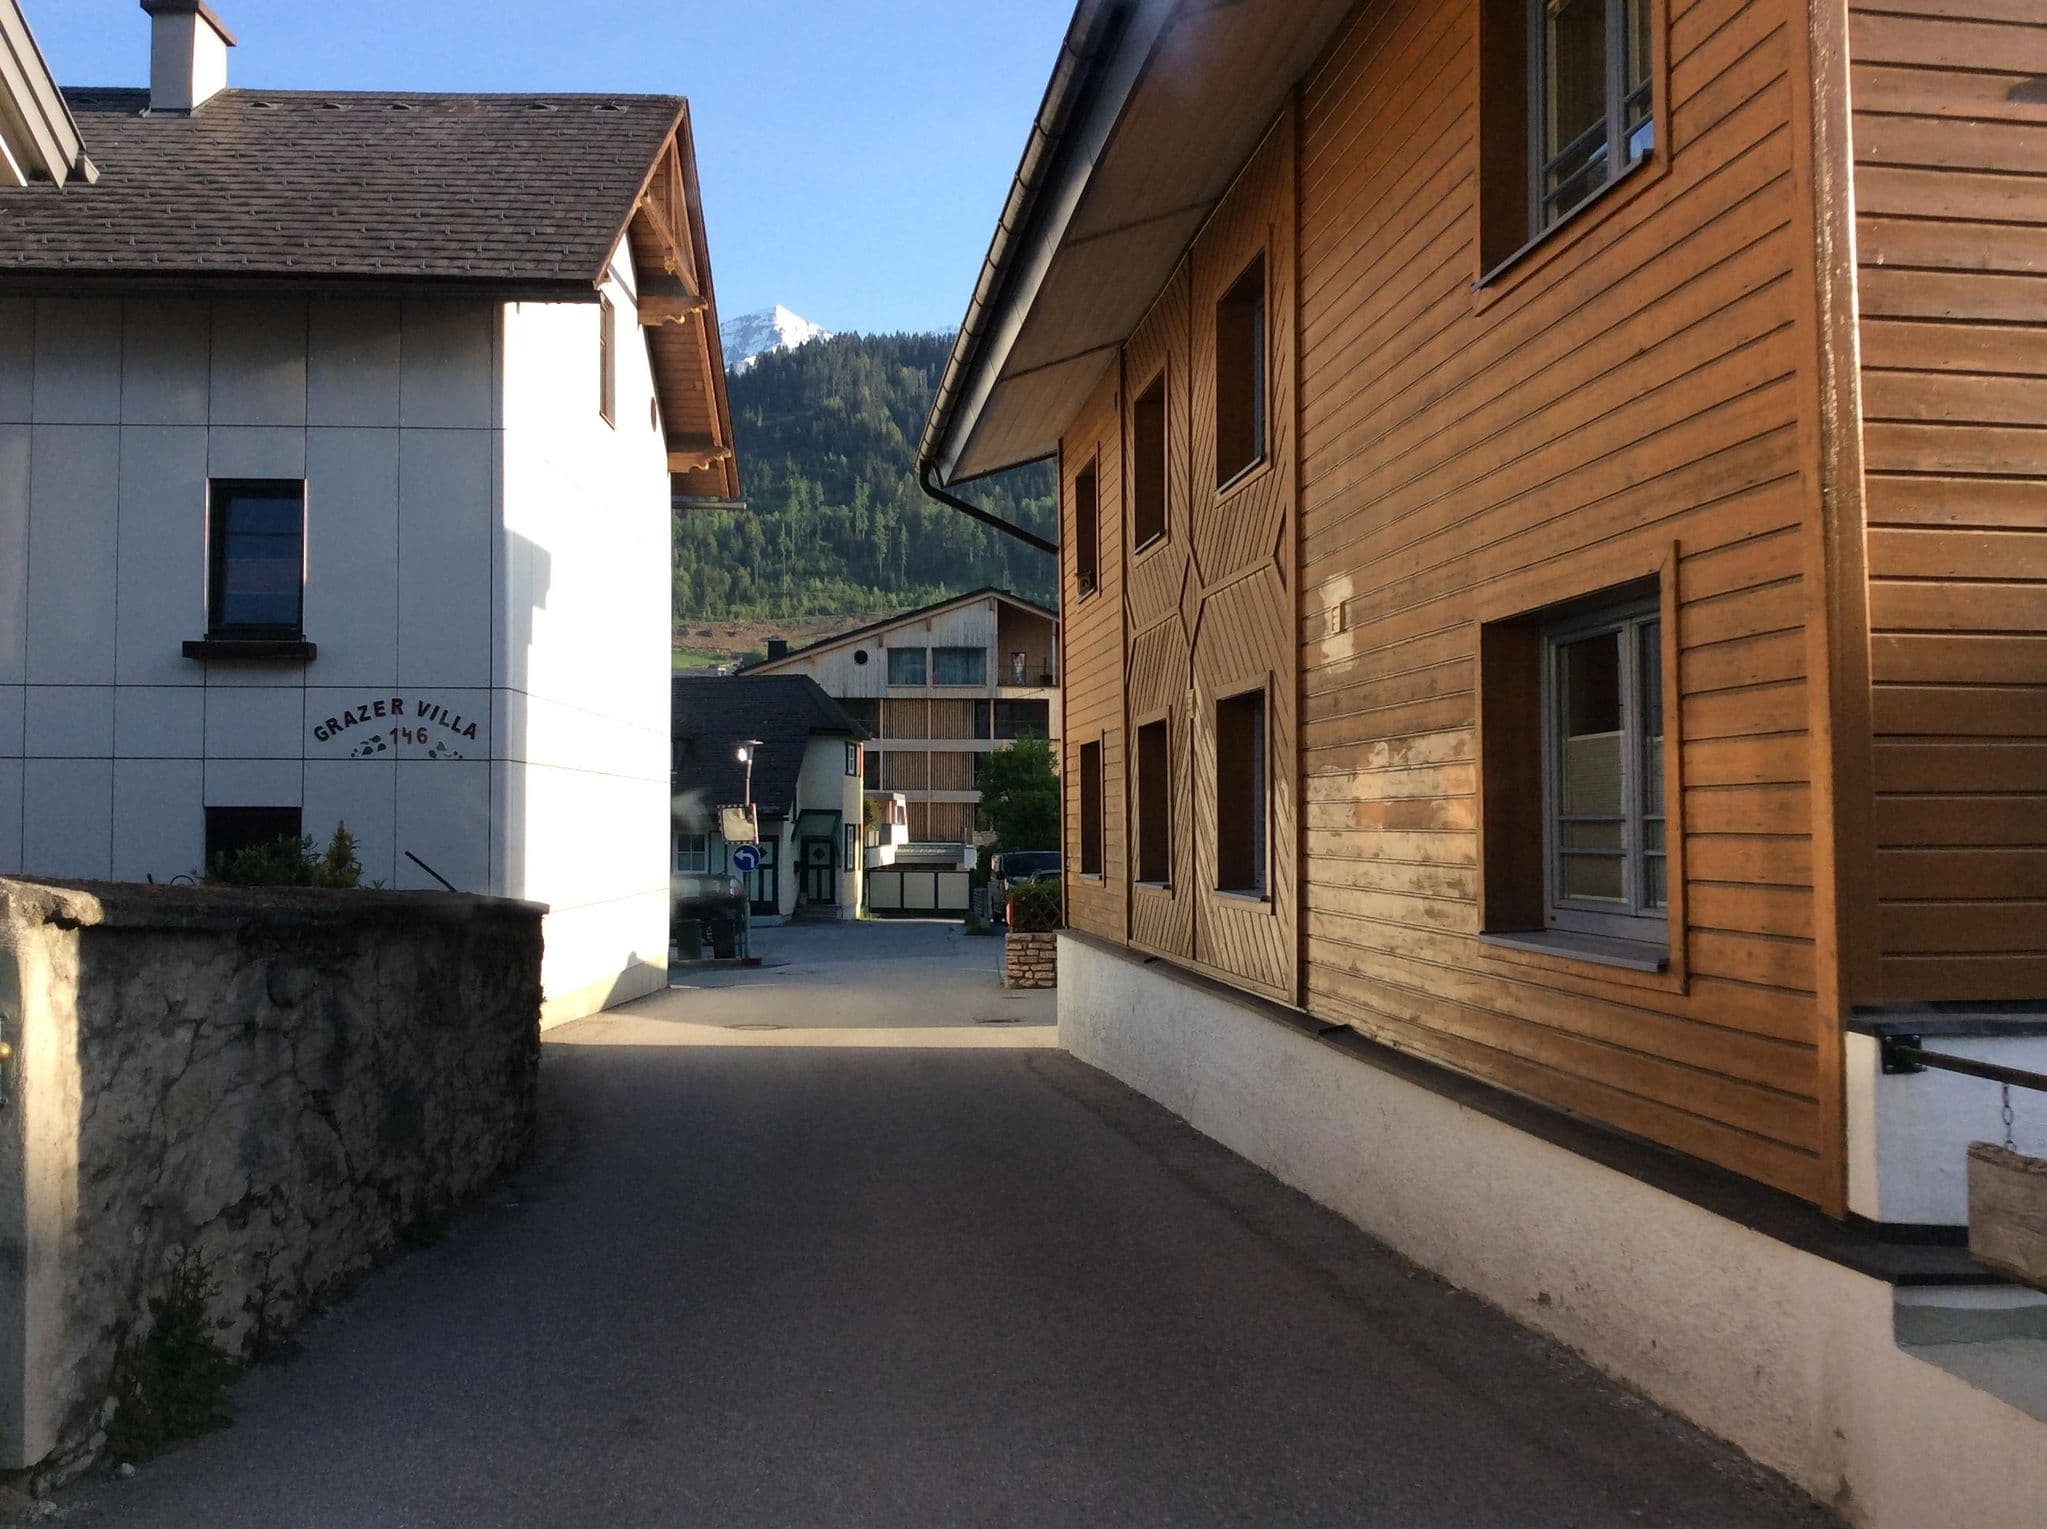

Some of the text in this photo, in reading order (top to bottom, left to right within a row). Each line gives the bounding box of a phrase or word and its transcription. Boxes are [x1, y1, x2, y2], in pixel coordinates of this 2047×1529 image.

[313, 698, 477, 742] GRAZER VILLA
[390, 727, 428, 745] 146
